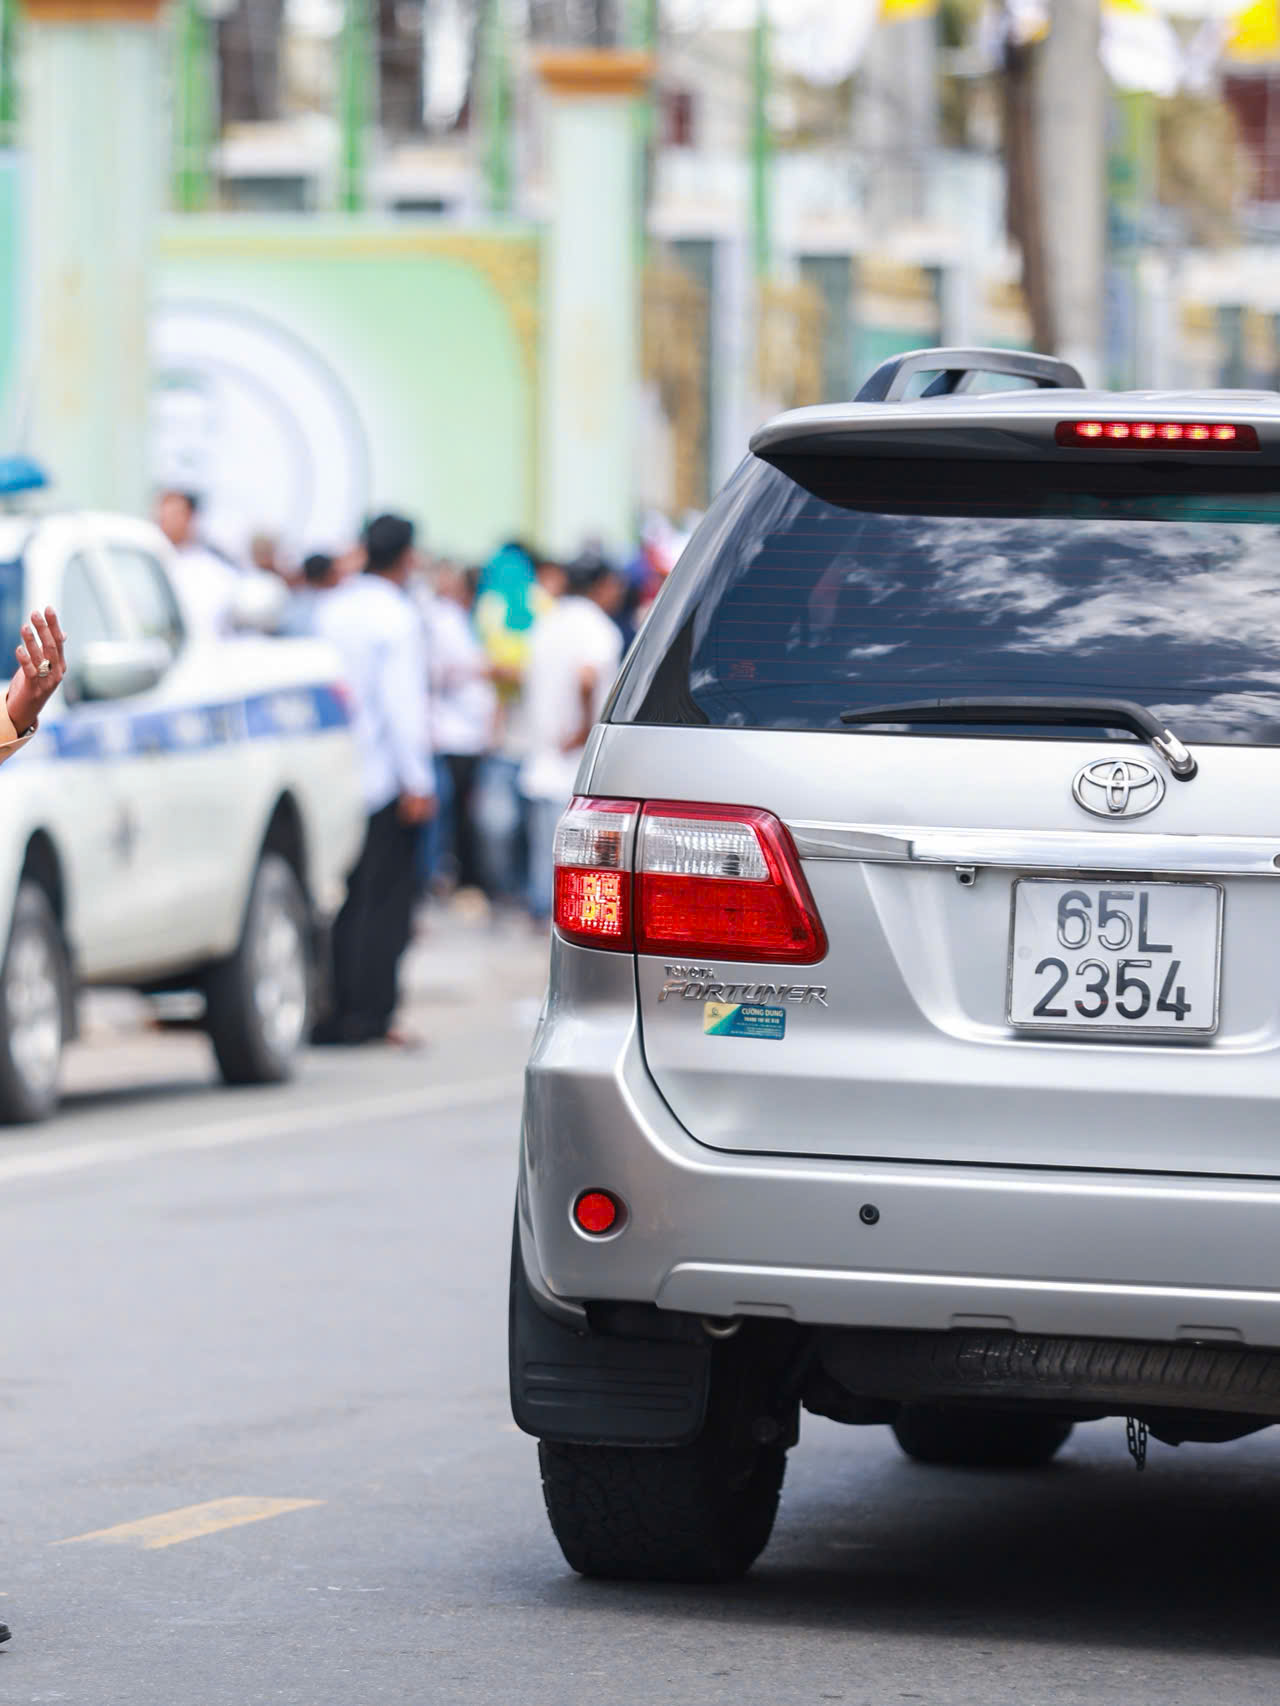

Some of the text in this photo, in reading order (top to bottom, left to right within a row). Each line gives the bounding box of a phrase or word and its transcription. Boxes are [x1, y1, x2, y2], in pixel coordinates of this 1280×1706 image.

[1056, 889, 1173, 953] 65L
[657, 979, 829, 1007] FORTUNER
[663, 964, 715, 979] TOYOTA
[1032, 957, 1192, 1021] 2354
